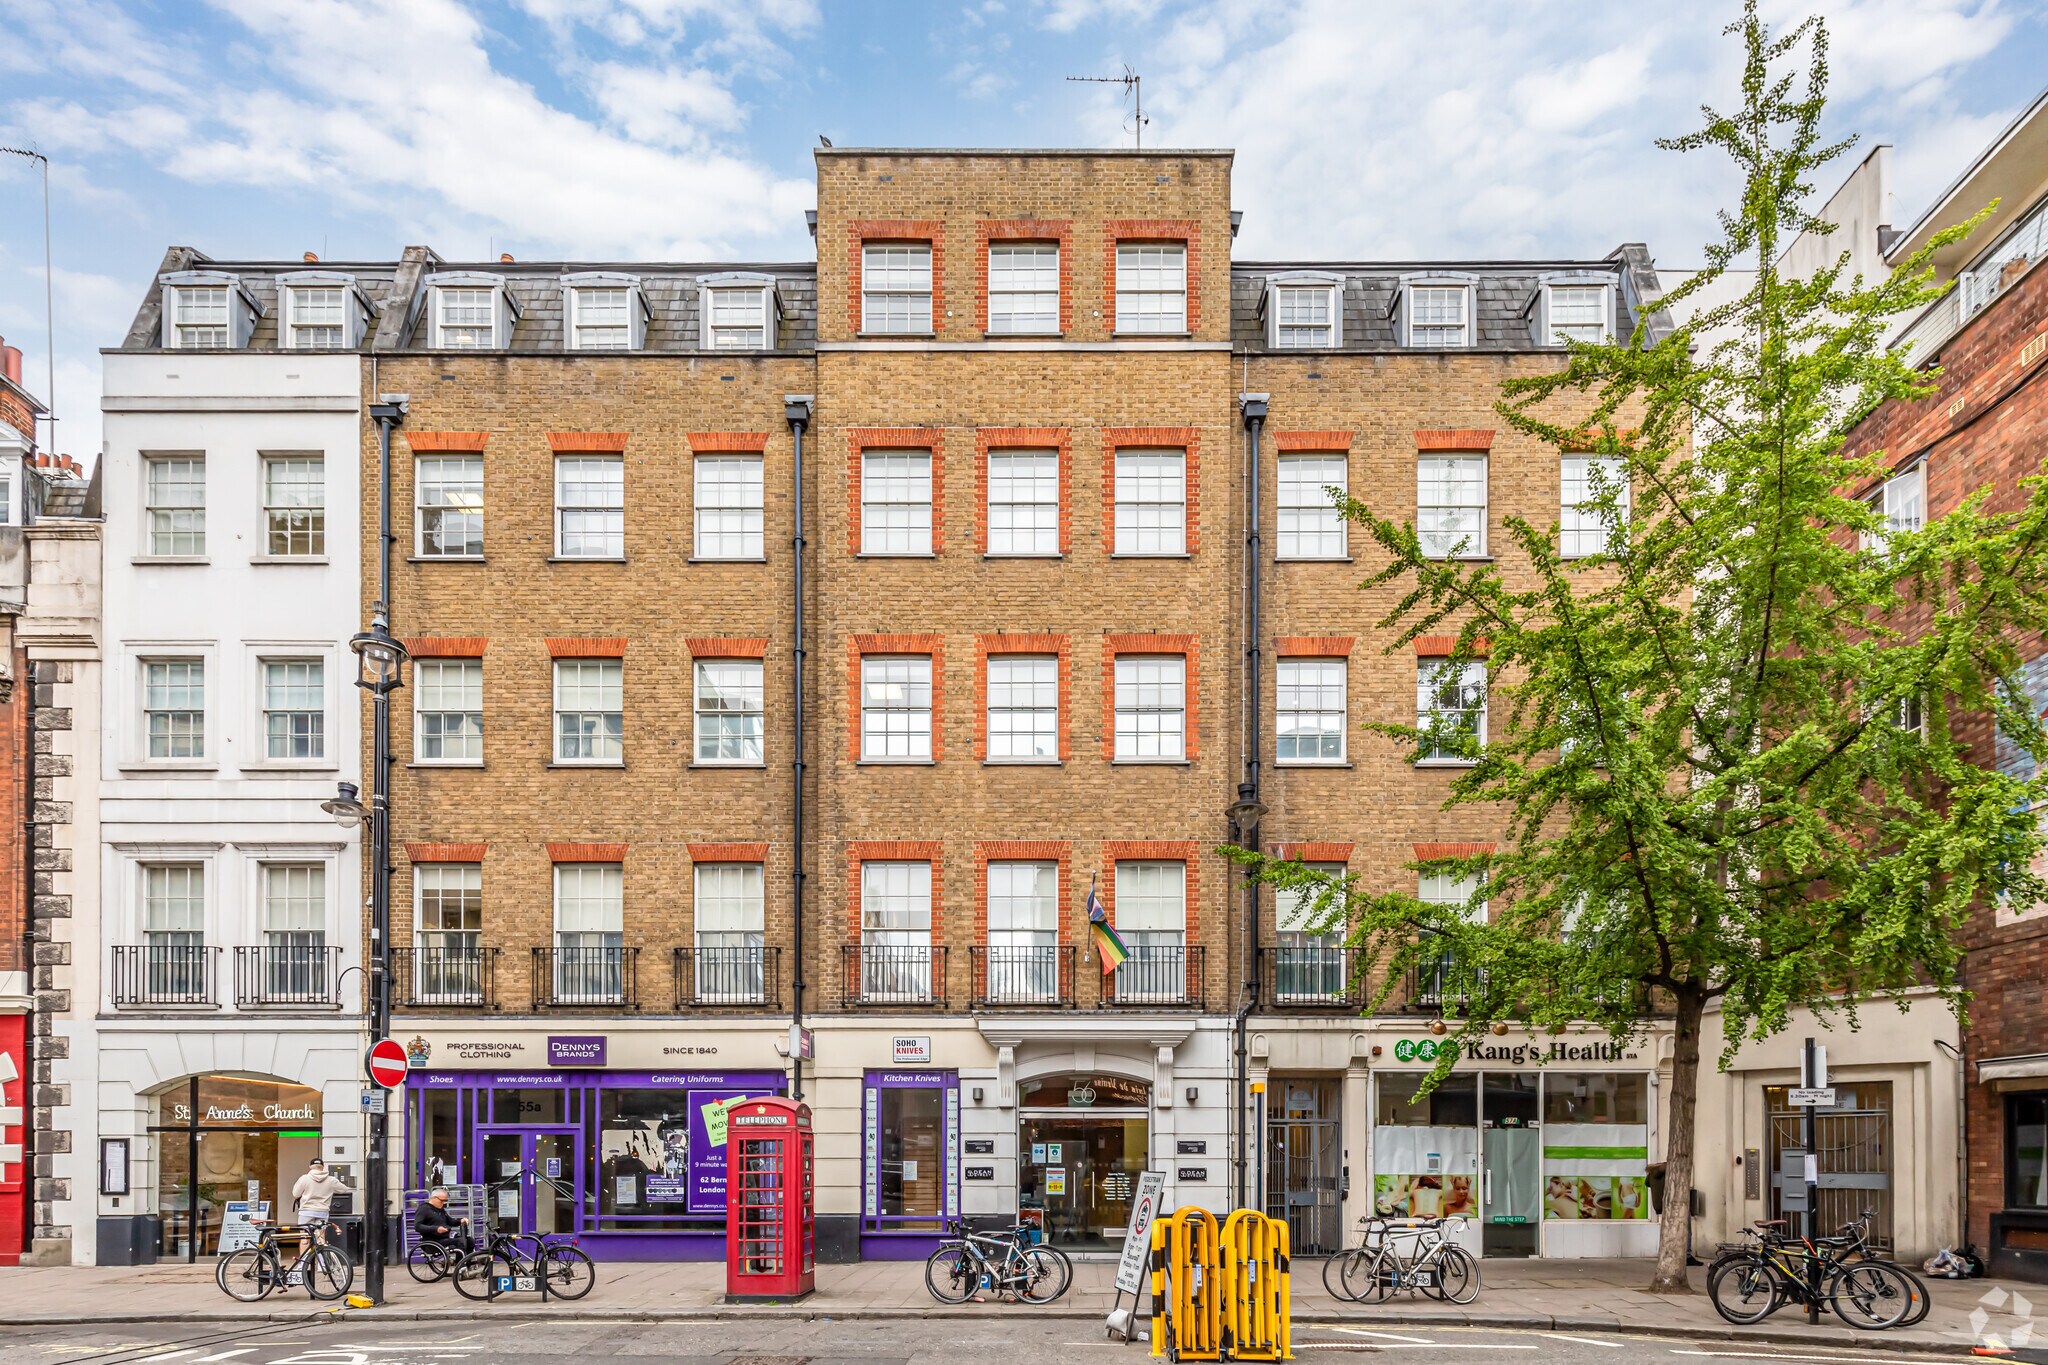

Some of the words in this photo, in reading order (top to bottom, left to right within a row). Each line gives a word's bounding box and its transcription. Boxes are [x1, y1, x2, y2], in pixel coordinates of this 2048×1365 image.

[551, 1042, 600, 1051] DENNYS
[896, 1039, 917, 1047] SOHO
[663, 1047, 694, 1055] SINCE
[696, 1047, 718, 1055] 1840
[896, 1047, 924, 1055] KNIVES
[1397, 1041, 1436, 1058] 健康
[1467, 1042, 1540, 1064] Kang's
[1550, 1041, 1623, 1060] Health
[460, 1051, 511, 1059] CLOTHING
[429, 1075, 454, 1084] Shoes
[497, 1076, 563, 1084] www.dennys.co.uk
[651, 1075, 685, 1085] Catering
[687, 1075, 724, 1084] Uniforms
[884, 1074, 913, 1082] Kitchen
[915, 1074, 941, 1082] Knives
[1072, 1080, 1097, 1103] 56
[206, 1104, 252, 1120] Anne's
[263, 1103, 314, 1120] Church
[711, 1120, 728, 1130] MOV
[738, 1116, 785, 1125] TELEPHONE
[1143, 1184, 1157, 1194] ZONE
[501, 1277, 510, 1290] P
